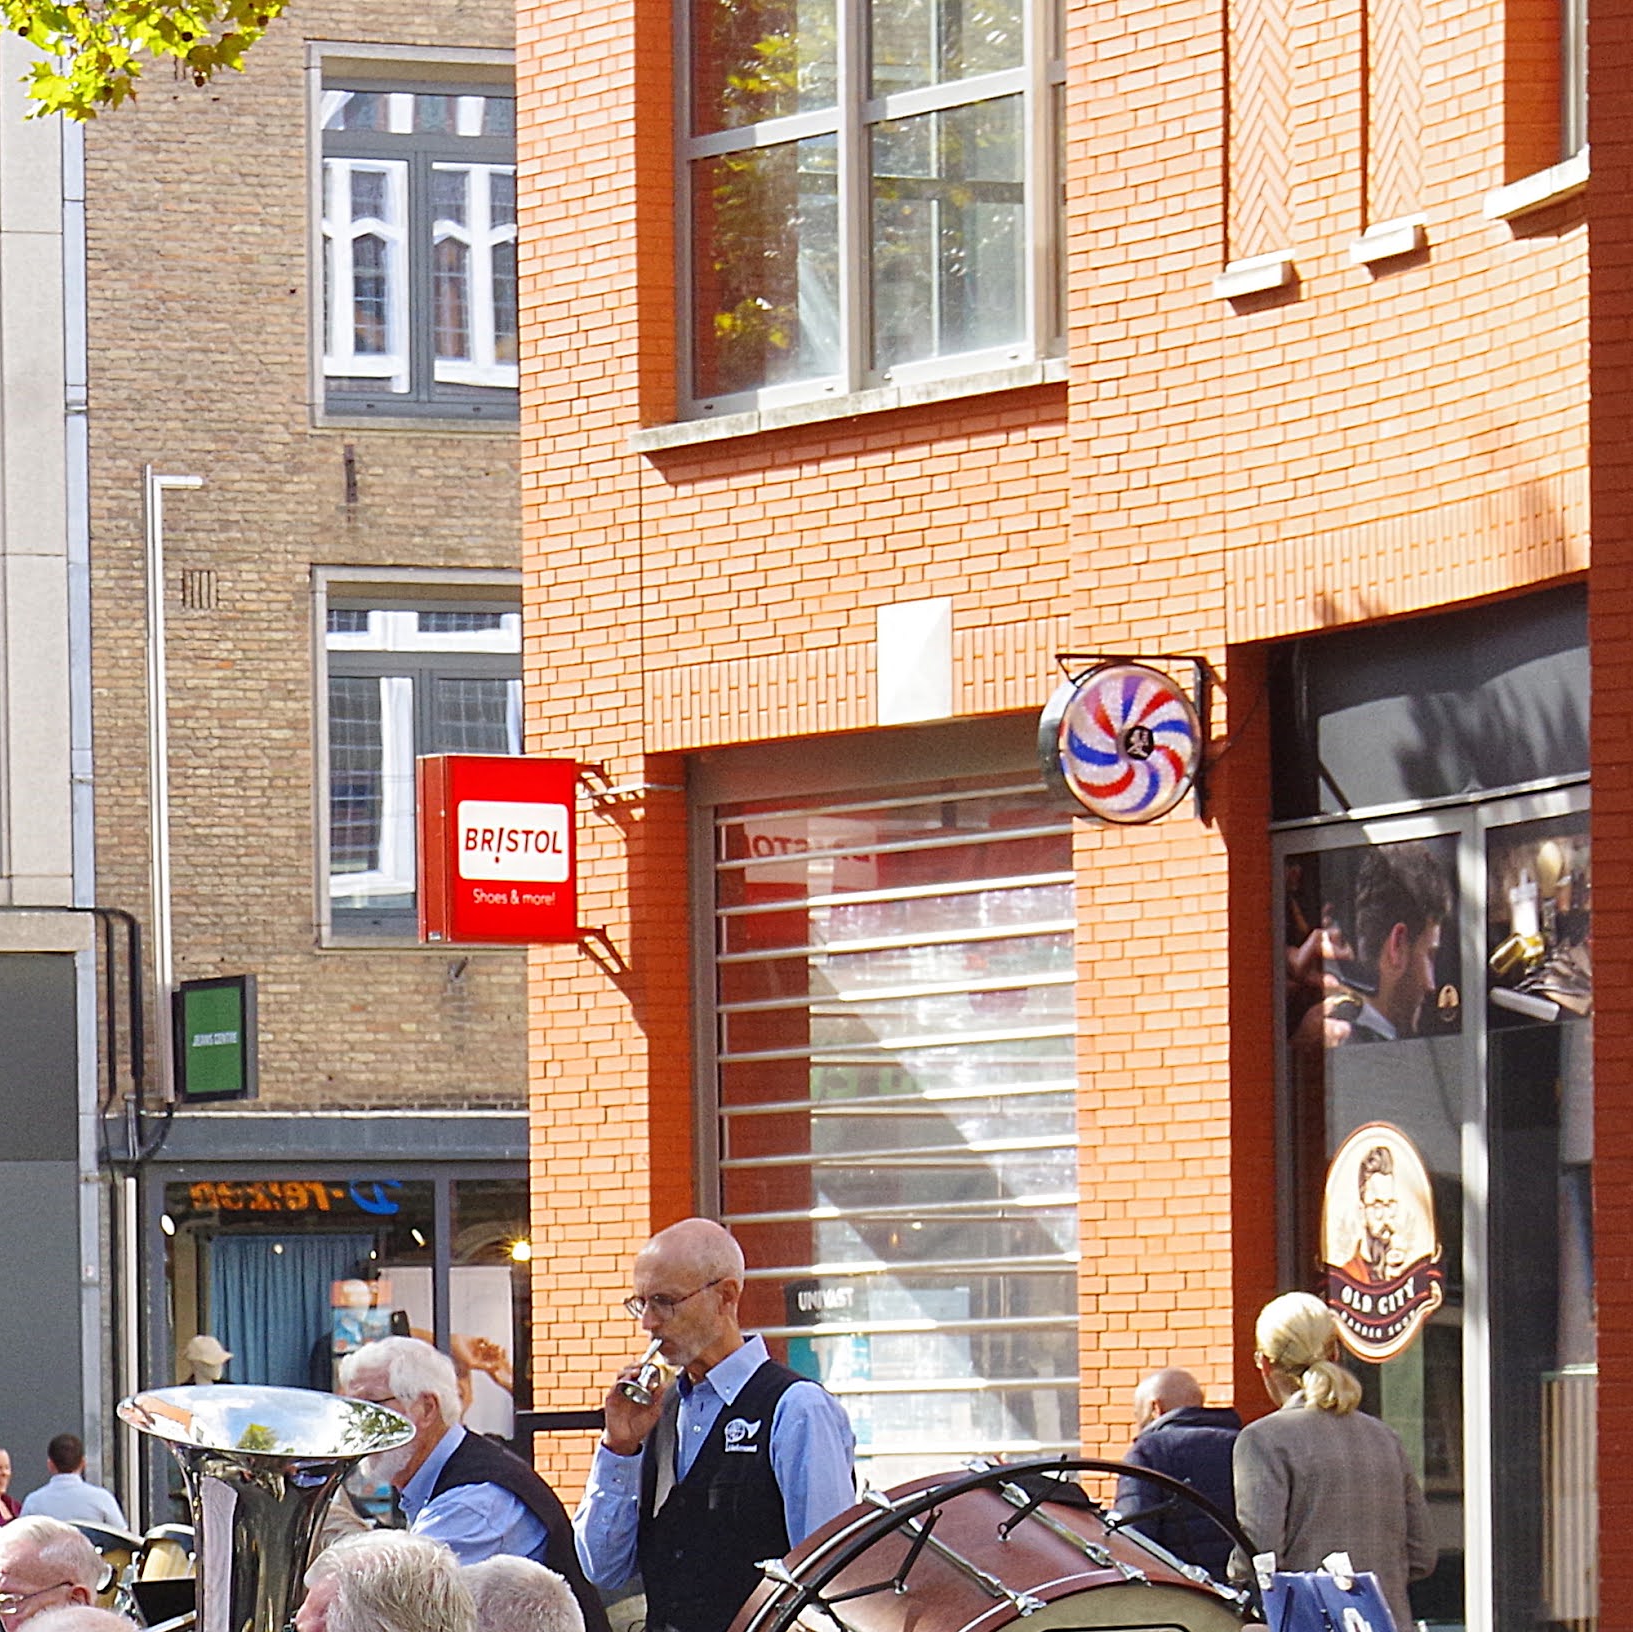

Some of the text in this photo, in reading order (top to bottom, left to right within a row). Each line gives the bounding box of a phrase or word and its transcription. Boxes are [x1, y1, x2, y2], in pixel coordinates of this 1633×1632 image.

[473, 888, 556, 905] Shoes & more!
[1341, 1276, 1415, 1316] OLD CITY
